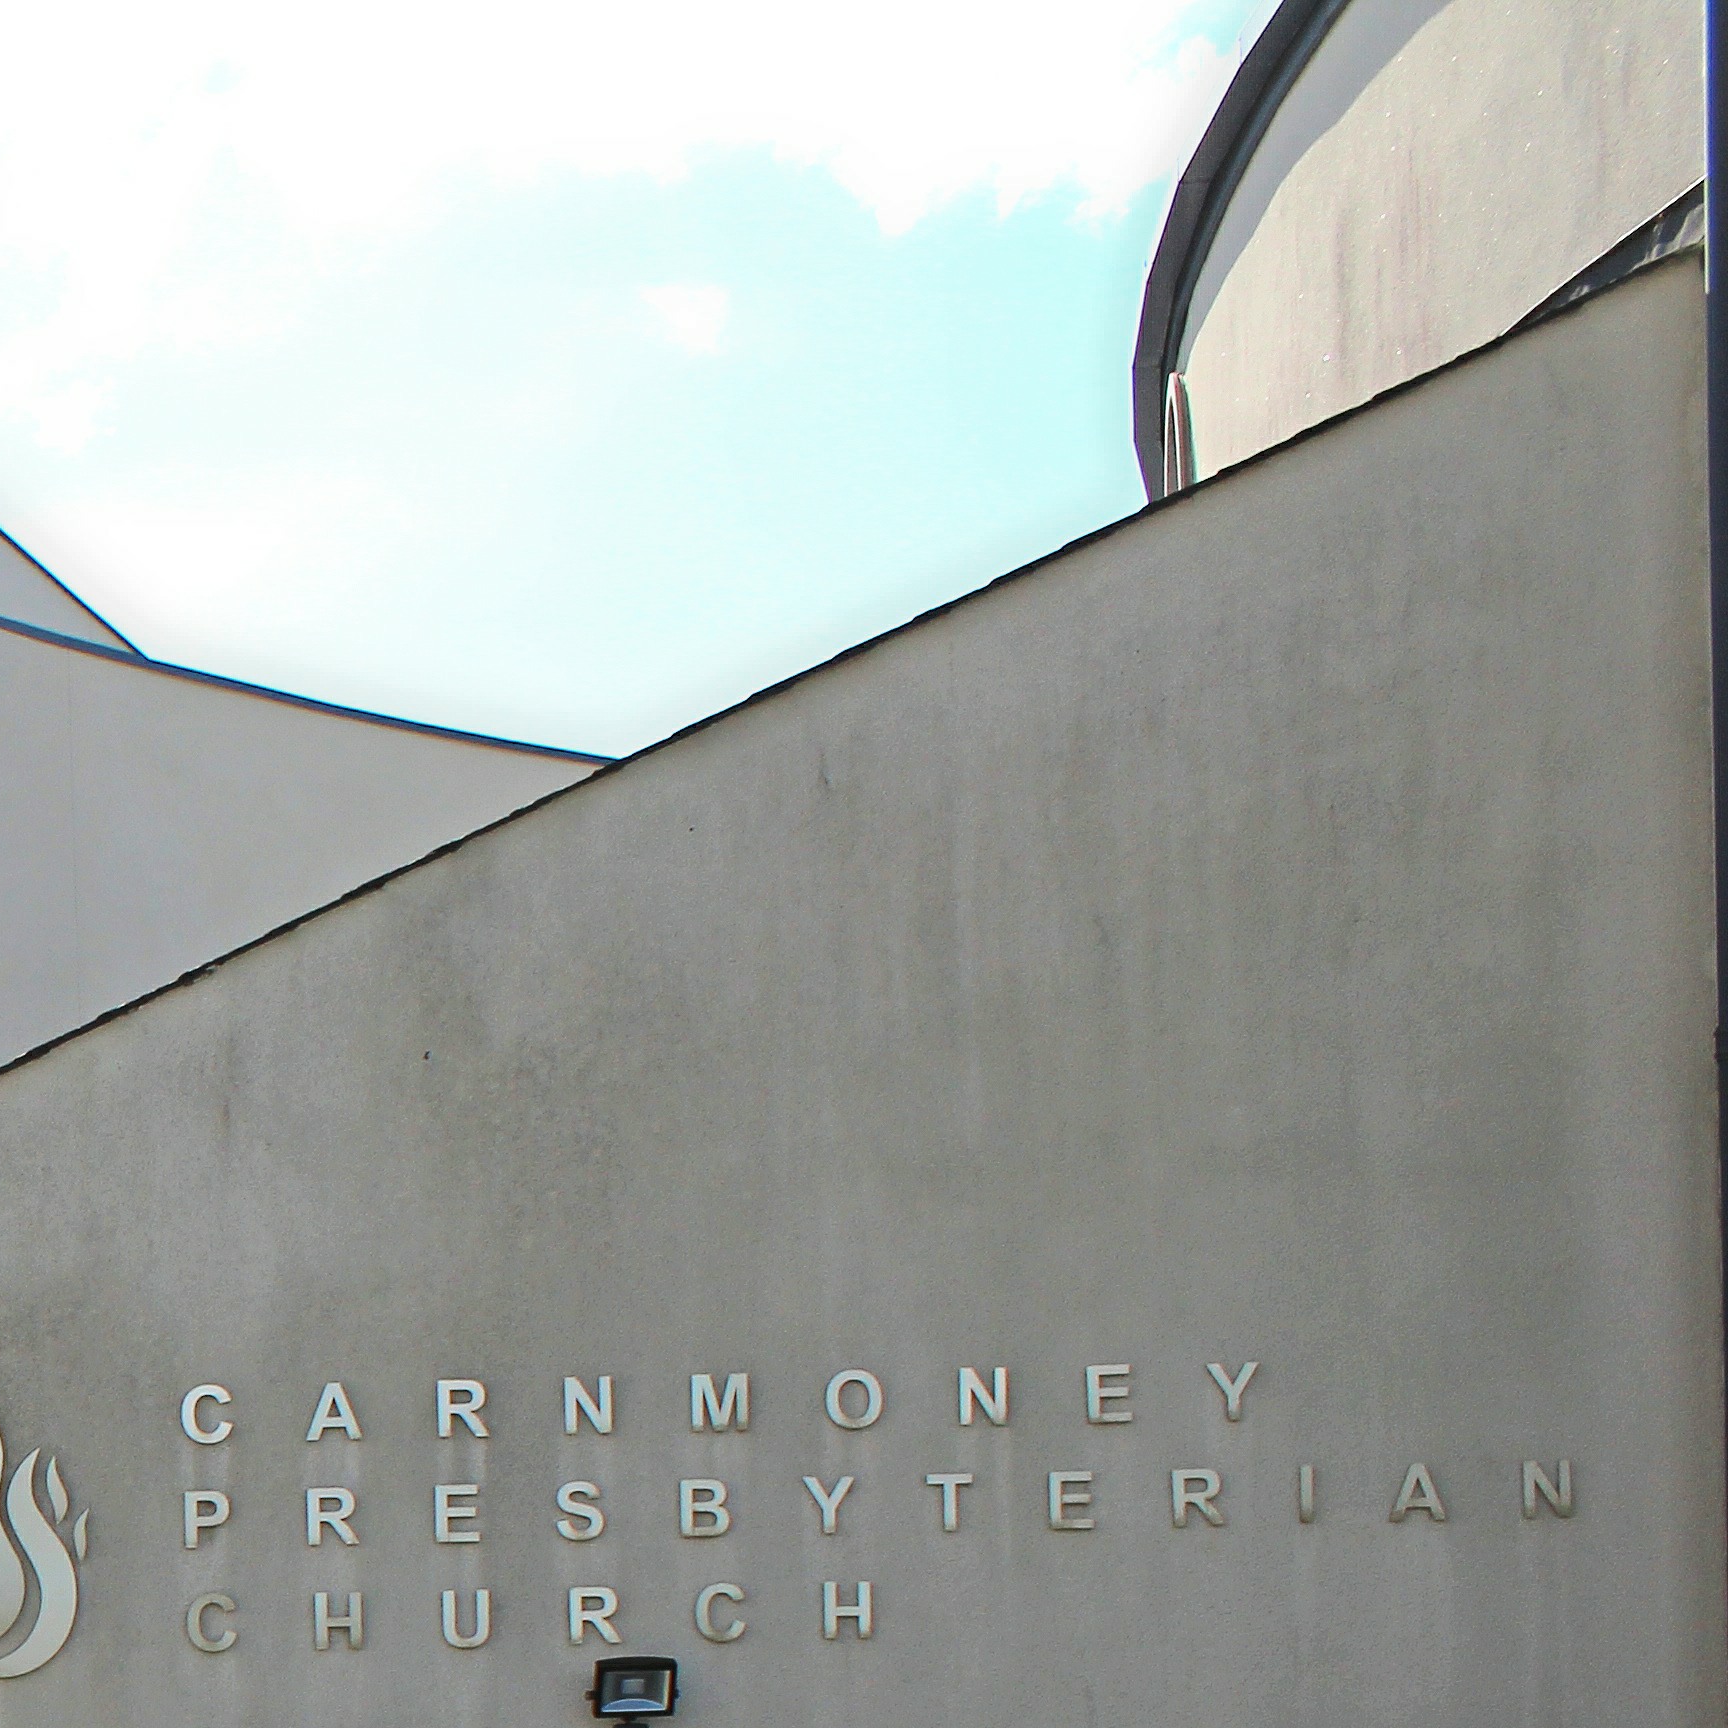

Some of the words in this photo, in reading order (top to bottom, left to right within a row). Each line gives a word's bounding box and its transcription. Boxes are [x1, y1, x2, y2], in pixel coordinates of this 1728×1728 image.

[180, 1361, 1259, 1444] CARNMONEY
[183, 1459, 1573, 1549] PRESBYTERIAN
[186, 1579, 874, 1653] CHURCH
